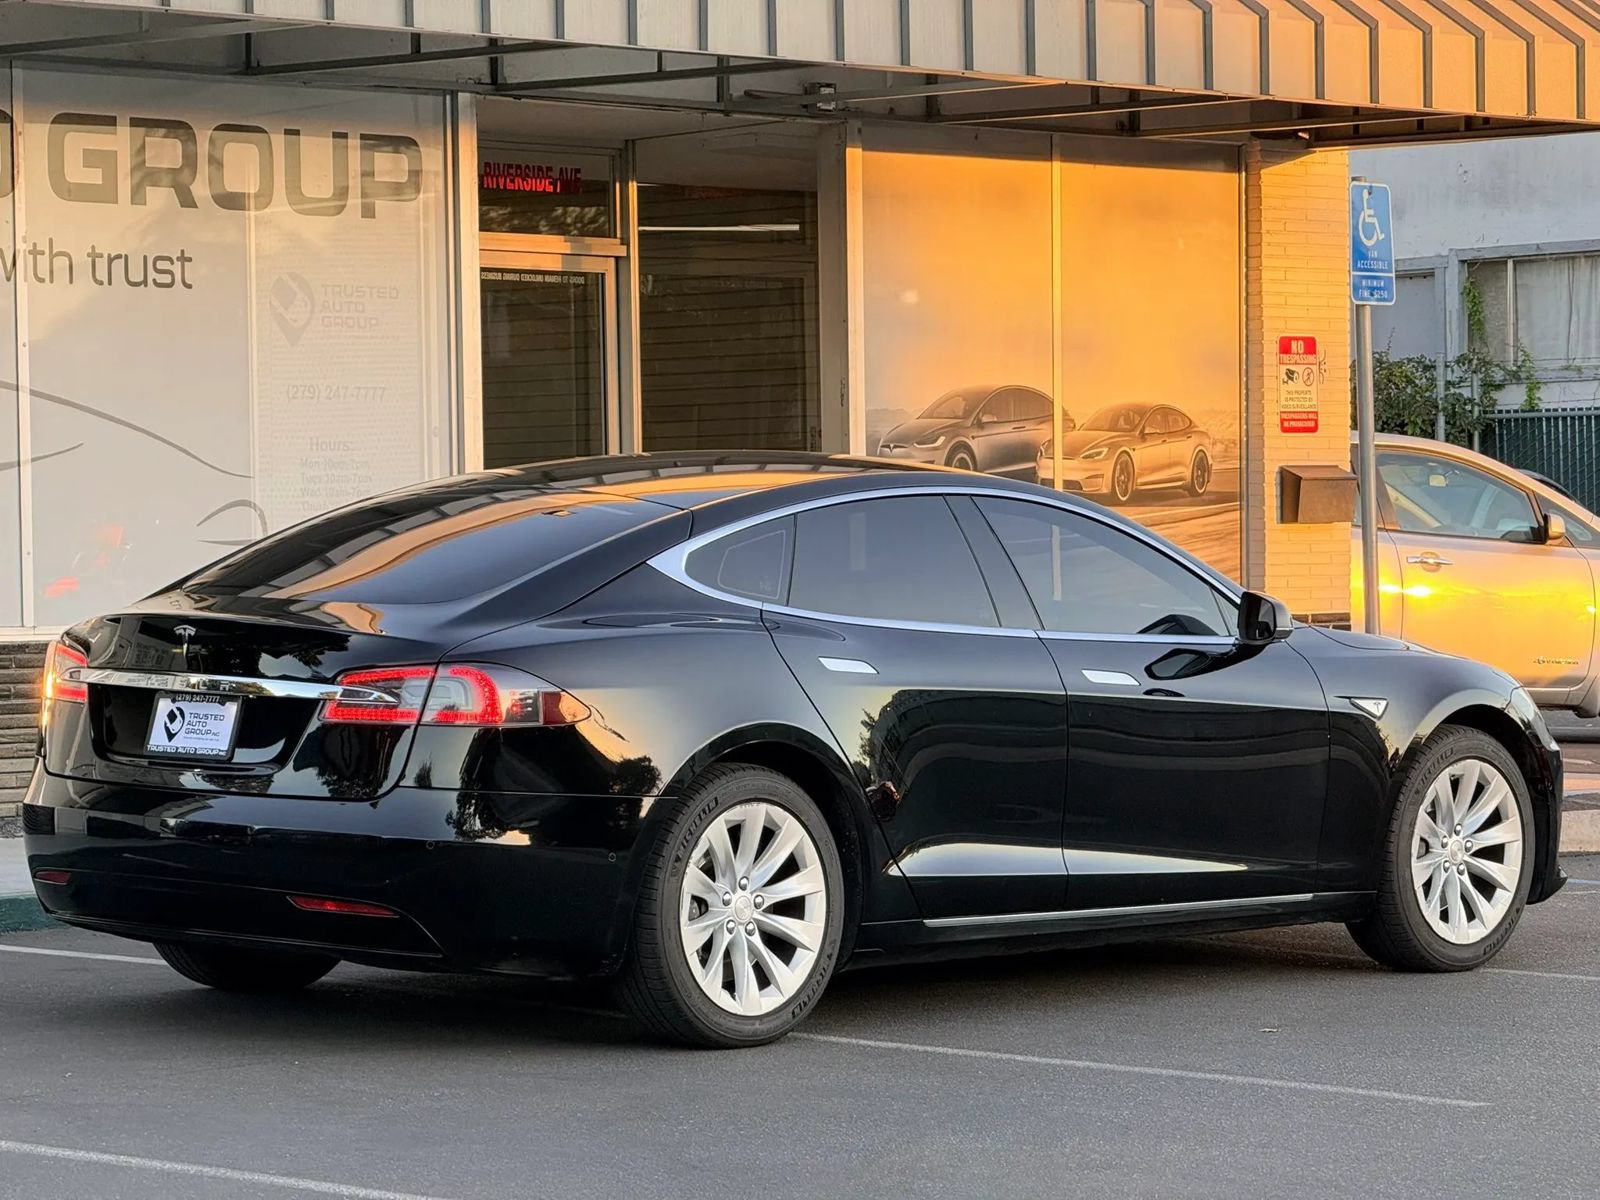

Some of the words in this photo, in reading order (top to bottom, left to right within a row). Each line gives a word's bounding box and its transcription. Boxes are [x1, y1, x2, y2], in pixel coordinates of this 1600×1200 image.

[47, 111, 423, 219] GROUP
[483, 162, 554, 193] RIVERSIDE
[557, 167, 582, 193] AVE
[87, 244, 193, 289] trust
[1357, 260, 1389, 270] ACCESSIBLE
[320, 284, 399, 299] TRUSTED
[320, 300, 366, 313] AUTO
[320, 315, 380, 330] GROUP
[1291, 339, 1305, 354] NO
[286, 384, 320, 403] (279)
[325, 385, 387, 401] 247-7777
[185, 720, 207, 728] AUTO
[188, 712, 225, 721] TRUSTED
[184, 728, 212, 736] GROUP
[147, 744, 177, 753] TRUSTED
[177, 745, 195, 754] AUTO
[196, 747, 219, 755] GROUP
